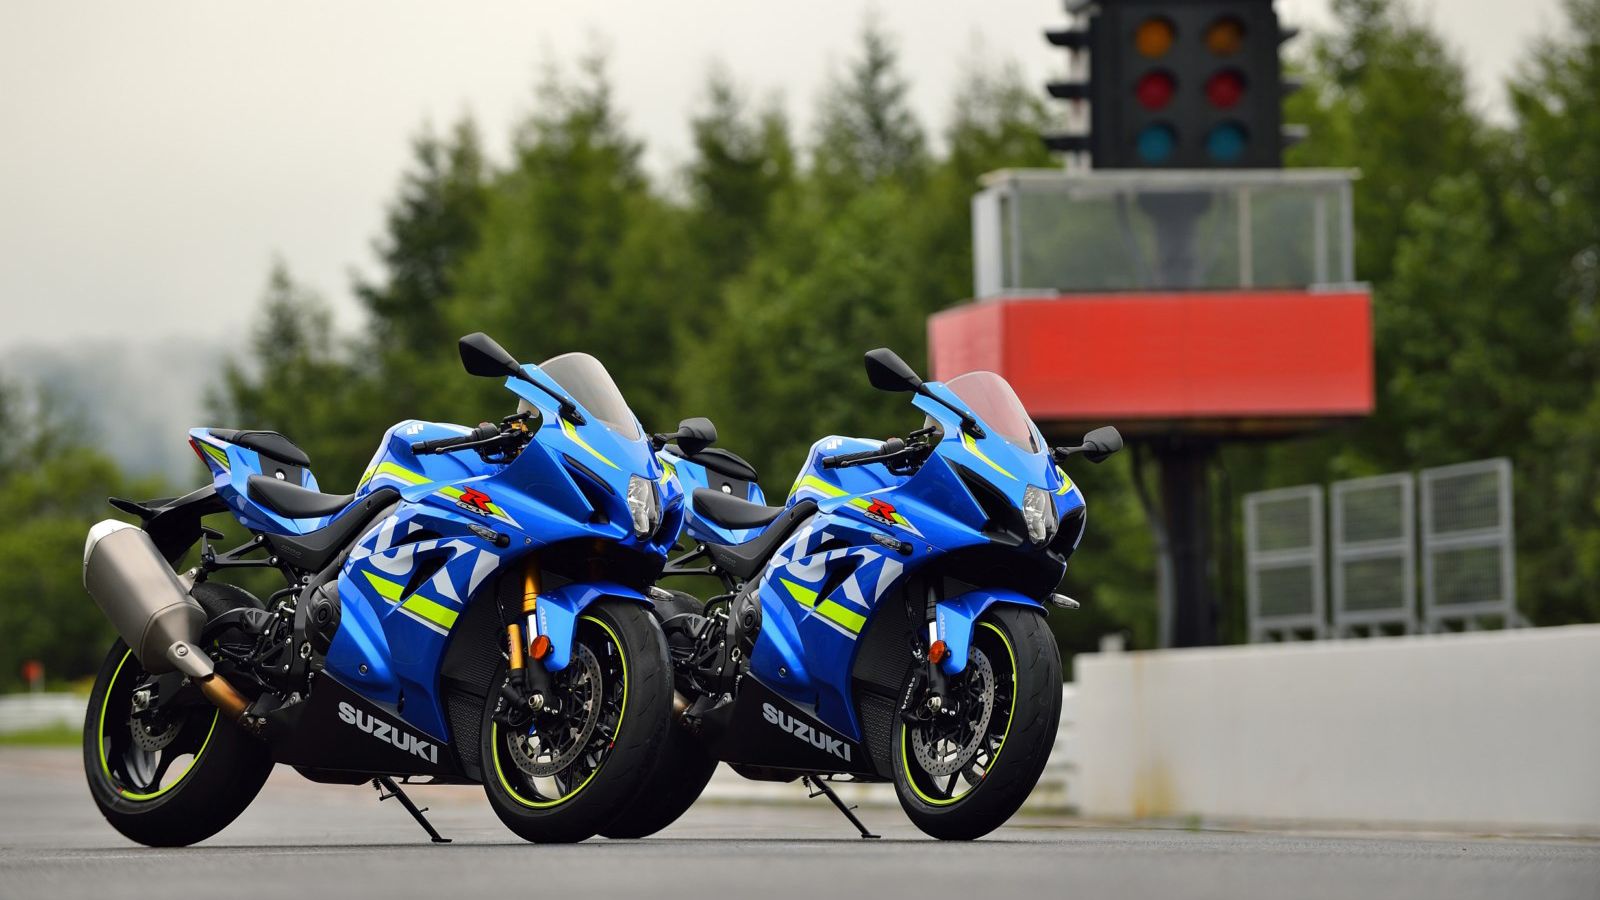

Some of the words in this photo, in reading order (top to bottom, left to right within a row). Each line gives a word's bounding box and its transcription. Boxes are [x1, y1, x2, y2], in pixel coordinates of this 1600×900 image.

[494, 677, 510, 712] brebo
[338, 700, 438, 764] SUZUKI
[762, 702, 852, 762] SUZUKI
